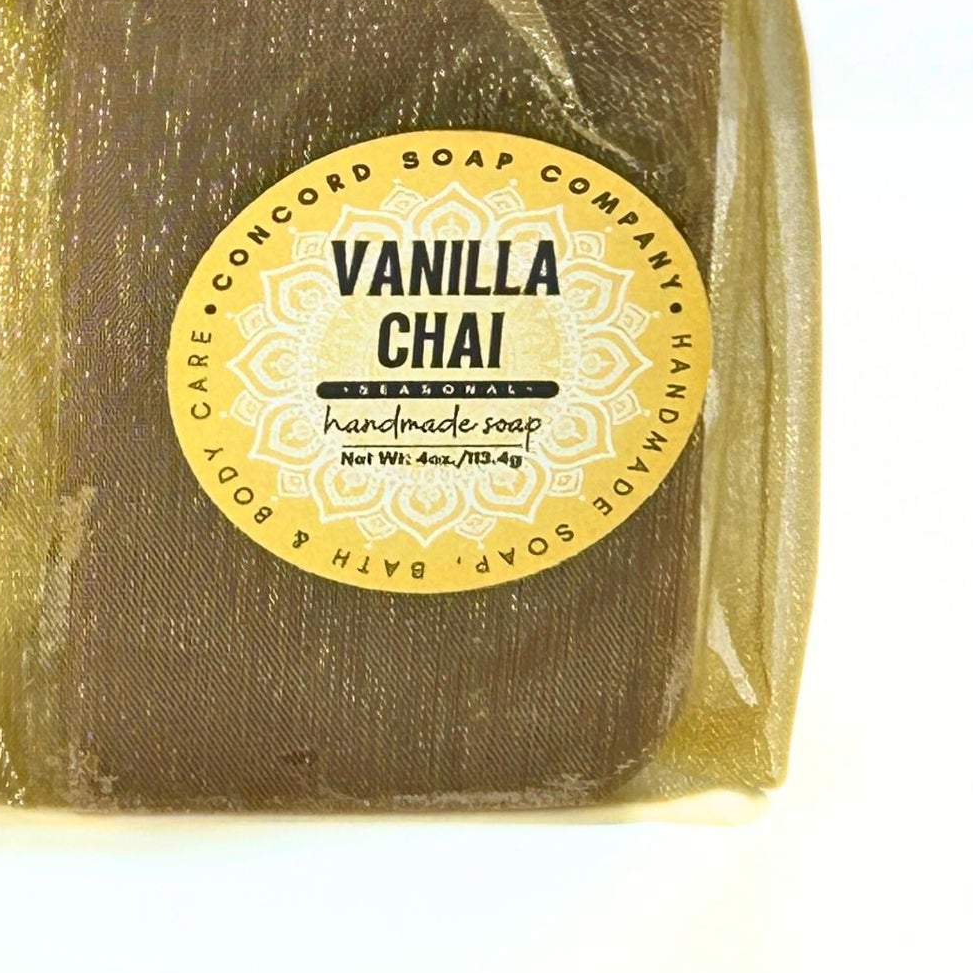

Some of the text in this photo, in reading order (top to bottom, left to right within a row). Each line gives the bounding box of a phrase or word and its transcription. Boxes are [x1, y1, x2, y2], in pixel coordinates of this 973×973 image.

[213, 147, 683, 292] CONCORD SOAP COMPANY
[331, 240, 561, 297] VANILLA
[377, 312, 505, 369] CHAI
[187, 330, 692, 580] HANDMADE SOAP, BATH & BODY CARE
[324, 404, 542, 452] handmade soap
